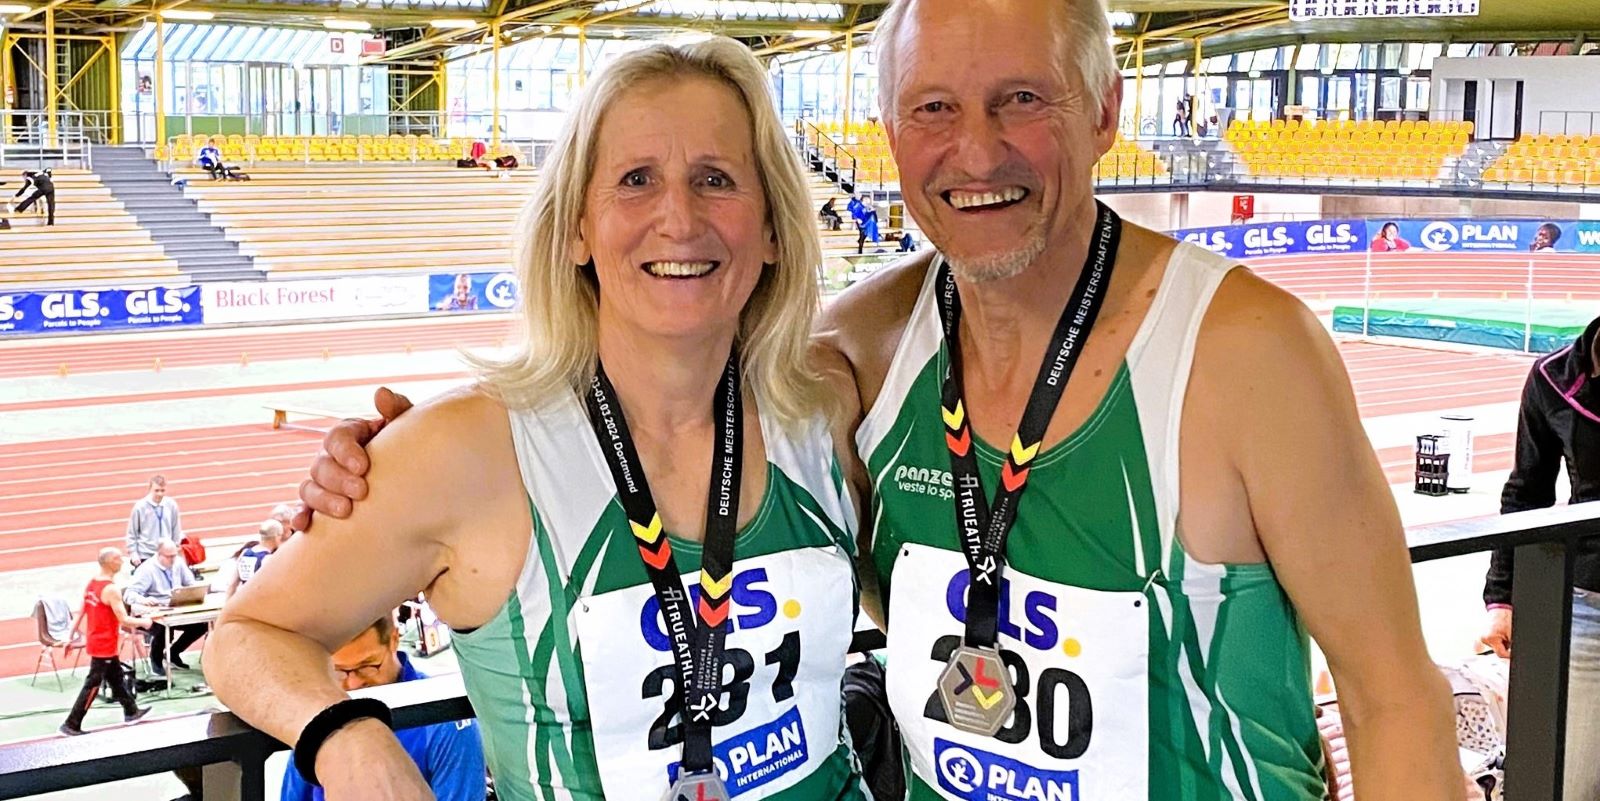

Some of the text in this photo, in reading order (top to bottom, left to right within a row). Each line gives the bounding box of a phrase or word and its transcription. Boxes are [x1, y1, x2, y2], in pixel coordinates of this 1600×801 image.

[332, 39, 343, 52] D
[1243, 227, 1294, 249] GLS.
[1305, 224, 1358, 244] GLS.
[1461, 225, 1518, 241] PLAN
[41, 293, 110, 320] GLS.
[125, 289, 191, 315] GLS.
[215, 287, 270, 308] Black
[277, 286, 335, 305] Forest
[1047, 326, 1080, 386] DEUTSCHE
[1074, 223, 1112, 325] MEISTERSCHAFTEN
[613, 442, 639, 493] Dortmund
[719, 456, 733, 516] DEUTSCHE
[898, 482, 925, 493] veste
[926, 486, 938, 496] lo
[641, 631, 801, 751] 281
[728, 720, 802, 775] PLAN
[736, 750, 804, 787] INTERNATIONAL
[987, 763, 1072, 801] PLAN
